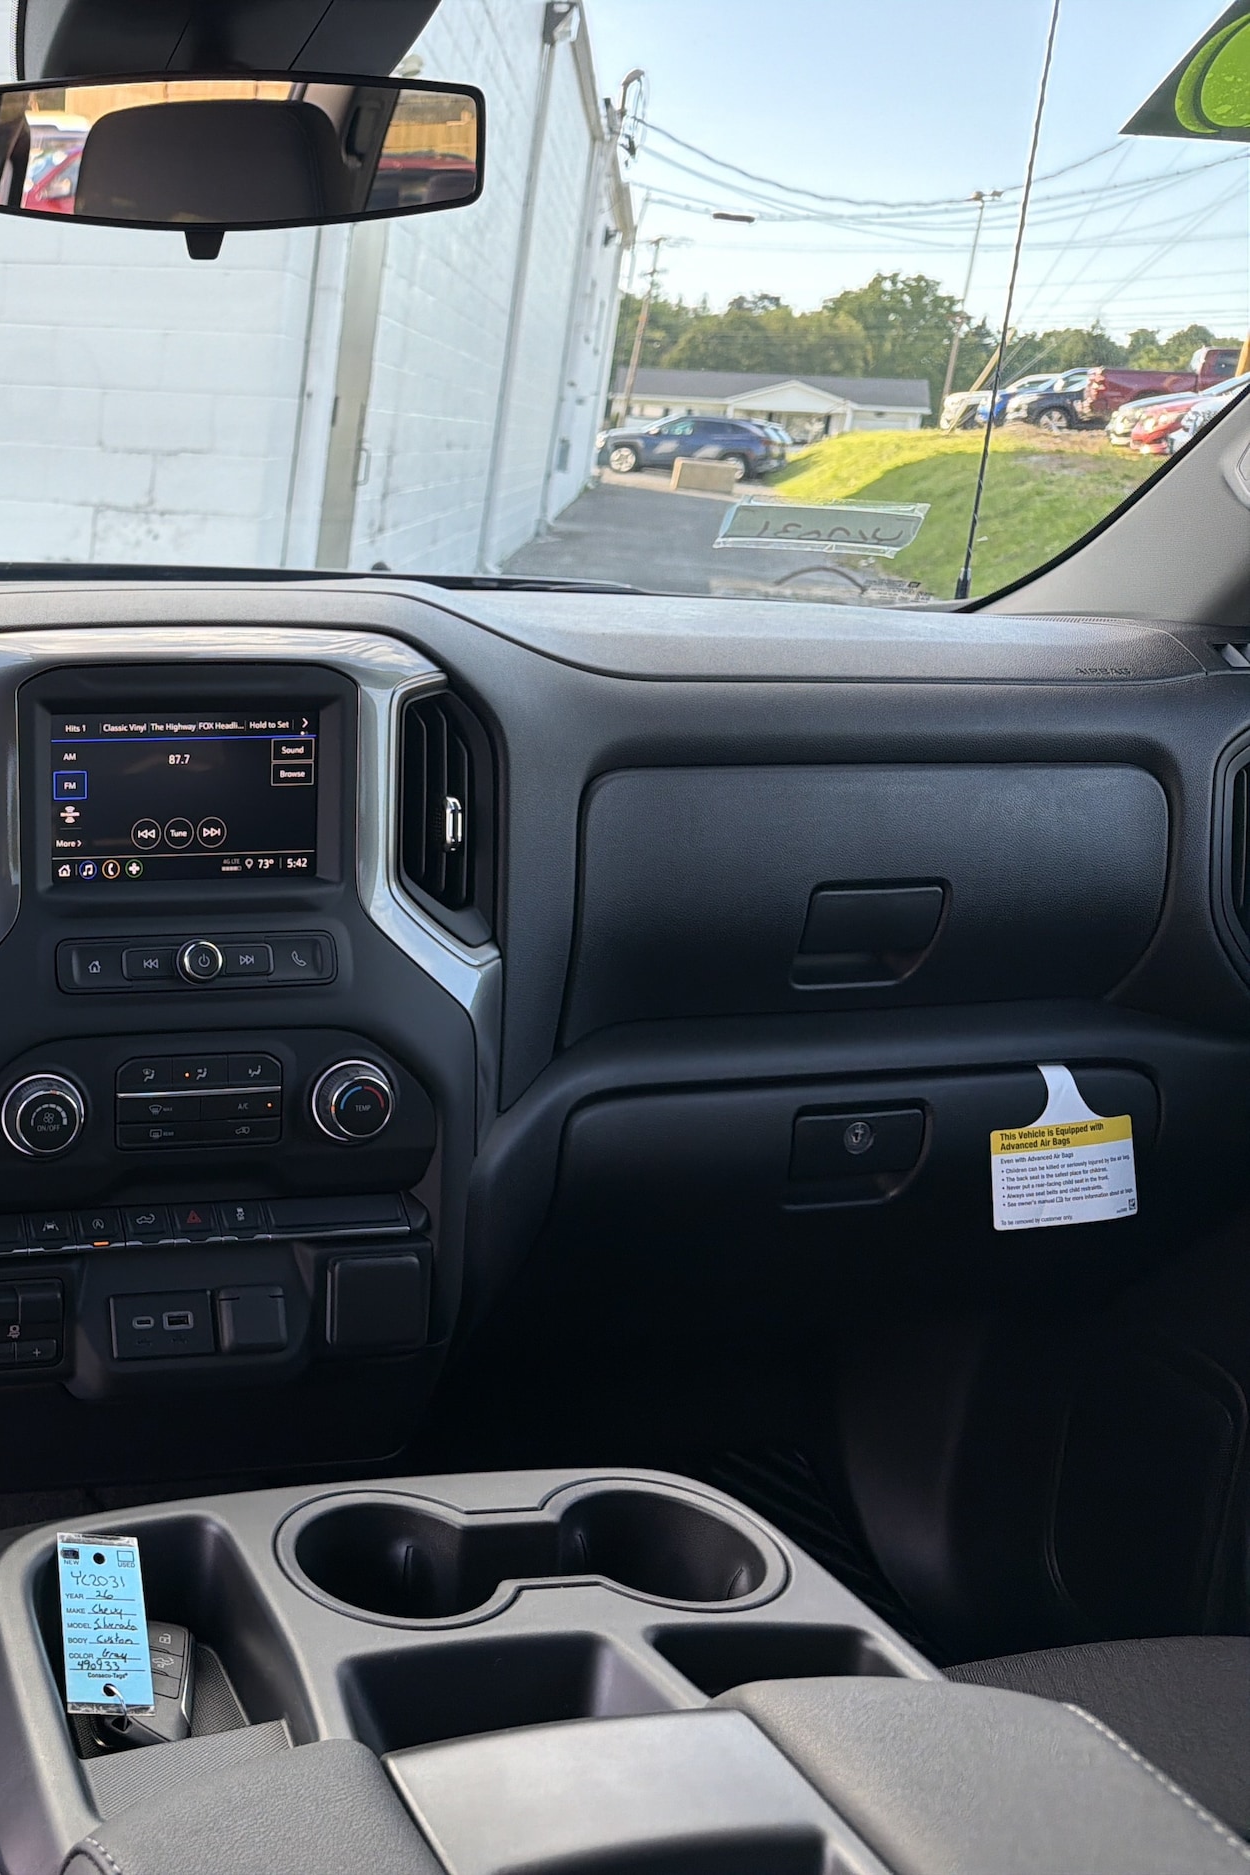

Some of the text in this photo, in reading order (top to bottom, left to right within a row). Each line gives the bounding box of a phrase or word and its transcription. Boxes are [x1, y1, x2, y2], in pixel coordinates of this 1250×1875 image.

[1075, 667, 1133, 677] AIRBAG
[65, 724, 86, 733] Hits 1
[102, 723, 147, 733] Classic Vinyl
[150, 722, 196, 733] The Highway
[198, 721, 245, 730] FOX Headli...
[249, 721, 289, 730] Hold to Set
[281, 746, 305, 755] Sound
[63, 753, 77, 761] AM
[168, 755, 190, 765] 87.7
[279, 770, 305, 778] Browse
[64, 782, 77, 790] FM
[170, 829, 188, 838] Tune
[56, 839, 76, 848] More
[287, 858, 308, 868] 5:42
[1000, 1122, 1104, 1141] This Vehicle is Equipped with
[1000, 1137, 1070, 1151] Advanced Air Bags
[1028, 1154, 1052, 1162] Advanced
